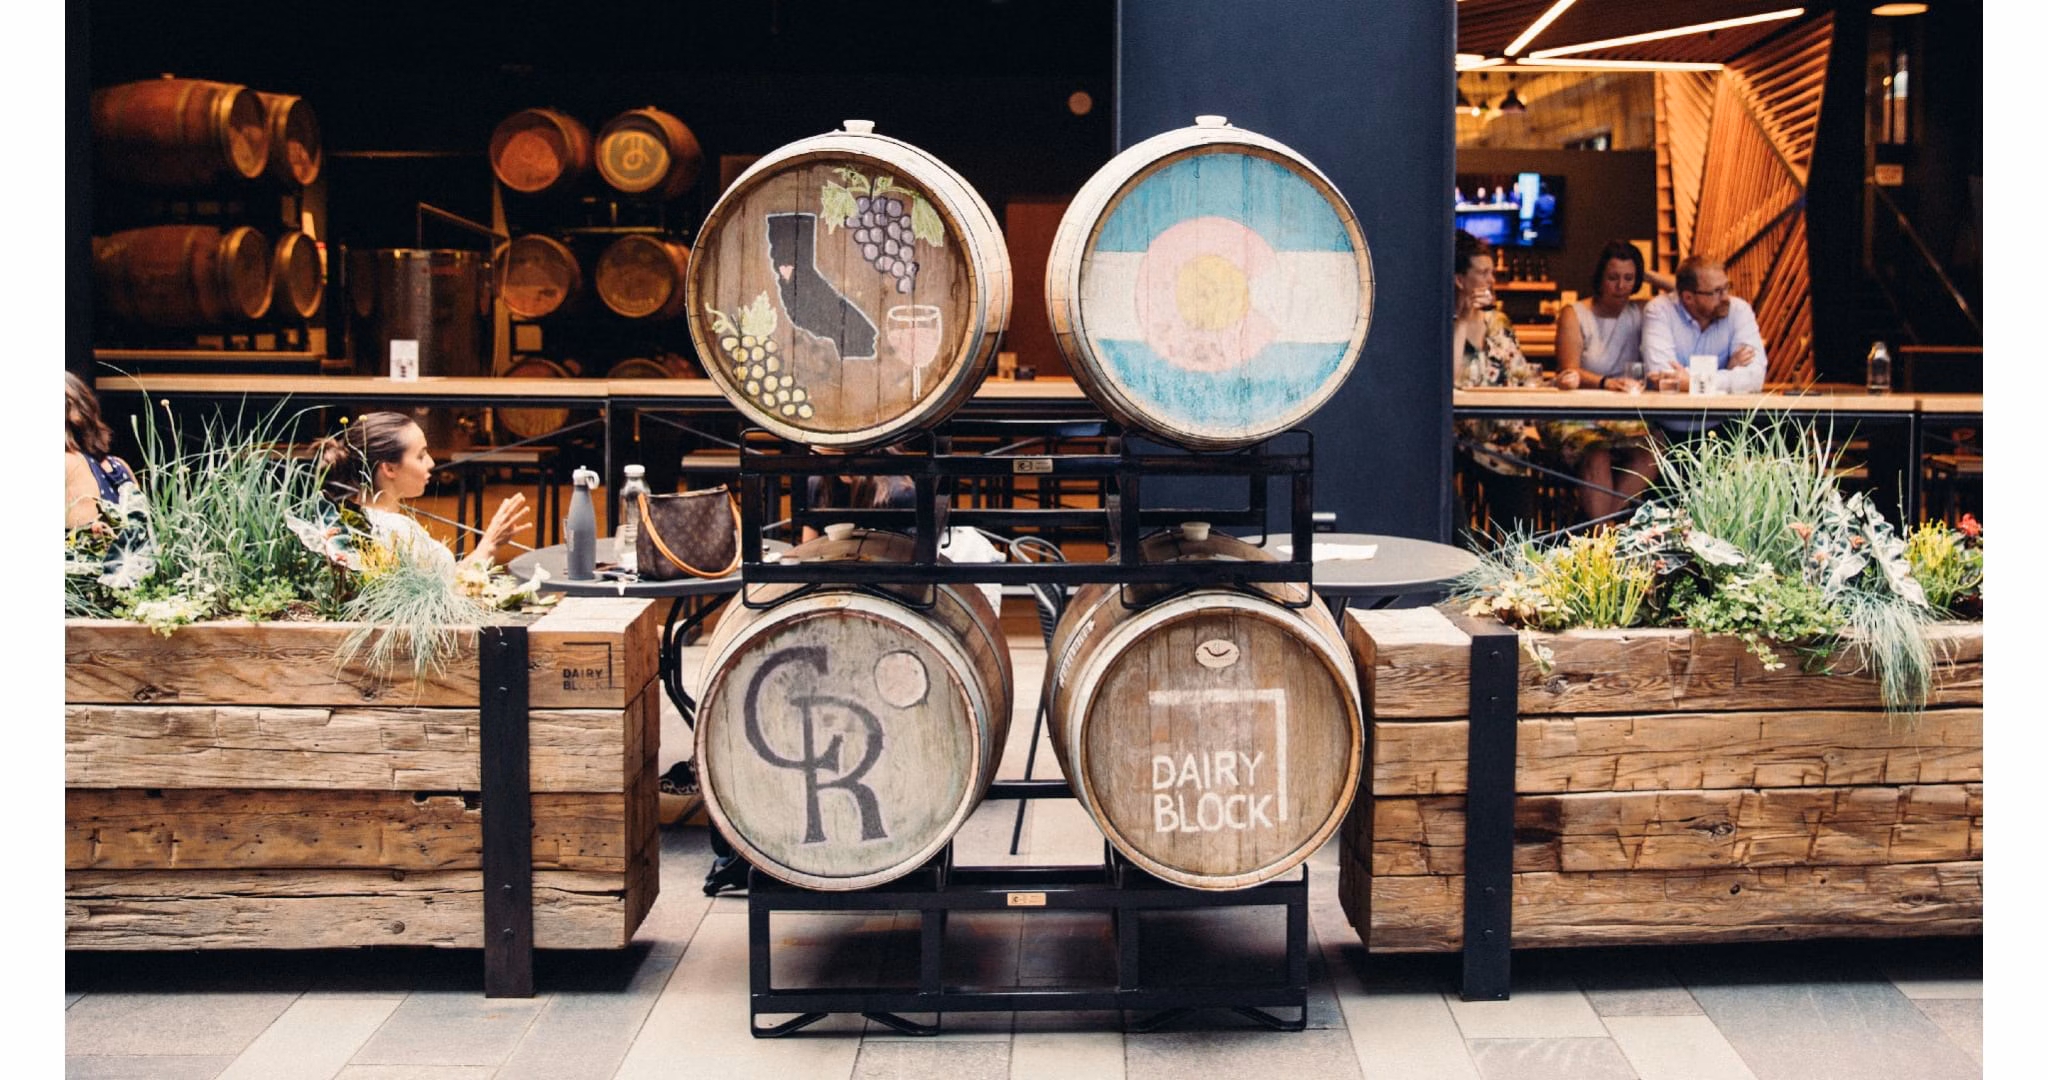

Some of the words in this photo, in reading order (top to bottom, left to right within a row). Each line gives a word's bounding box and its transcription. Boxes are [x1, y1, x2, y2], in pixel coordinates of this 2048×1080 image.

[563, 668, 603, 679] DAIRY
[563, 680, 606, 690] BLK
[1152, 751, 1264, 791] DAIRY
[1154, 792, 1274, 833] BLOCK
